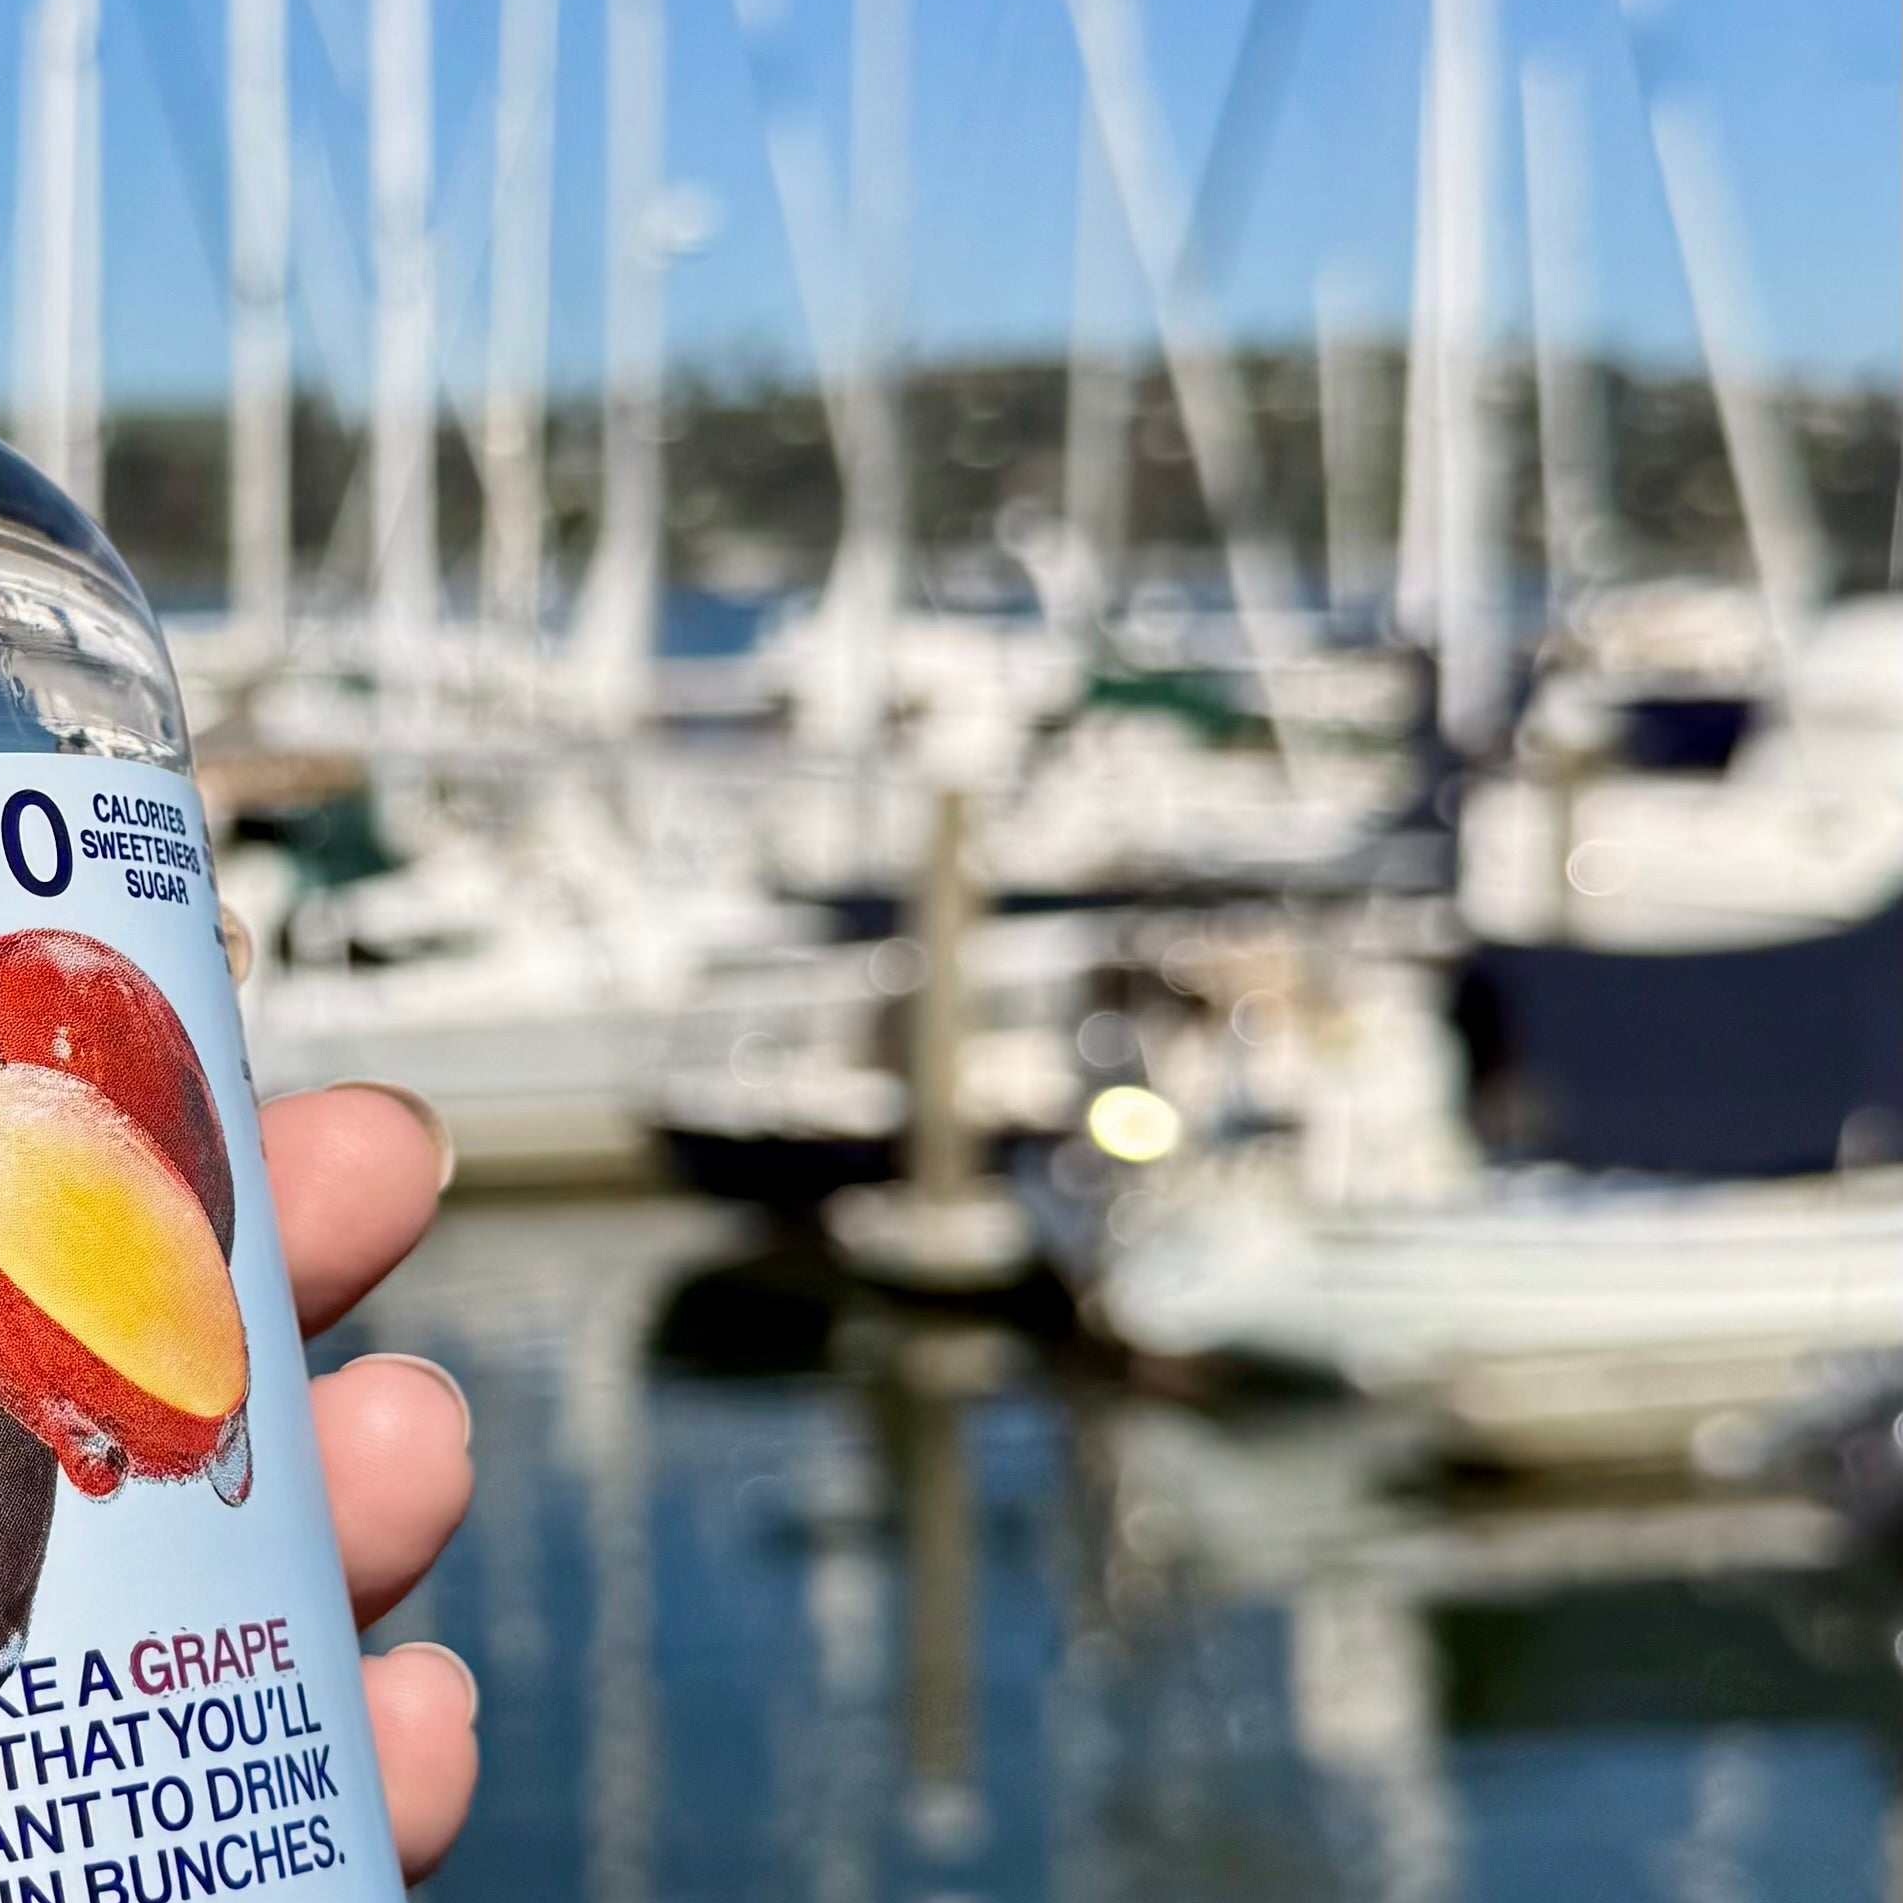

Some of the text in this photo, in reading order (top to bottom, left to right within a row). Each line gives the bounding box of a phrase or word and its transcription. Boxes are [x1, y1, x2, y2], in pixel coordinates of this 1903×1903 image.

[1, 789, 72, 897] 0
[81, 829, 200, 875] SWEETENERS
[92, 793, 186, 835] CALORIES
[125, 869, 189, 905] SUGAR
[79, 1649, 123, 1707] A
[129, 1618, 296, 1696] GRAPE
[159, 1683, 322, 1759] YOU'LL
[113, 1775, 193, 1839] TO
[206, 1744, 340, 1823] DRINK
